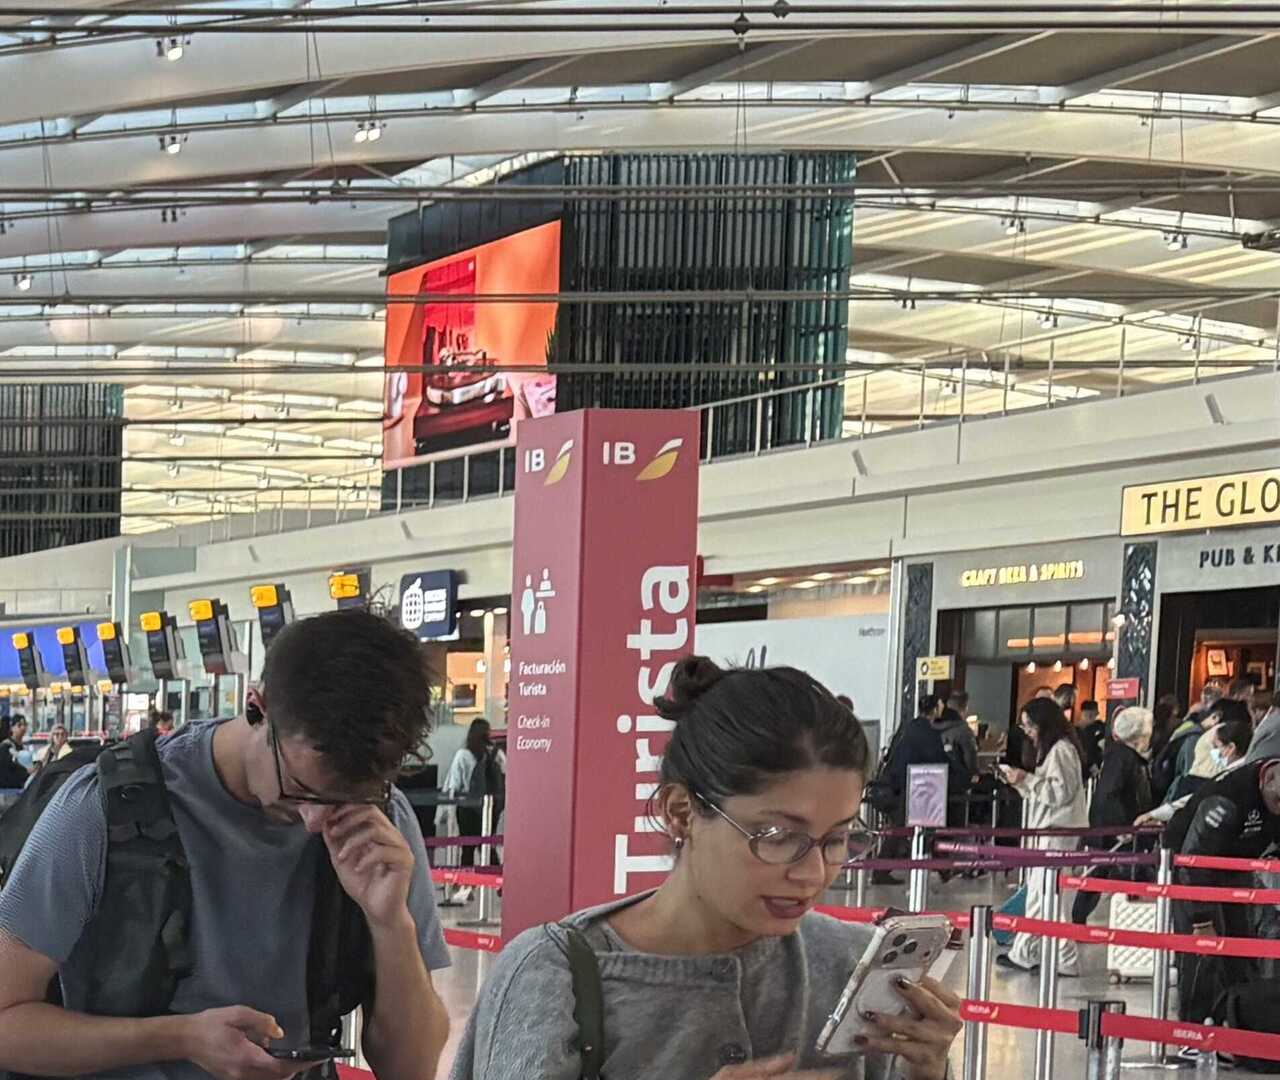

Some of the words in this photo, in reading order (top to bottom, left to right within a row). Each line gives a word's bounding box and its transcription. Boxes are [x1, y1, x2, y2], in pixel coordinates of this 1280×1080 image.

[525, 449, 545, 472] IB
[603, 442, 635, 465] IB
[1141, 486, 1202, 525] THE
[1199, 548, 1235, 568] PUB
[1243, 546, 1255, 565] &
[519, 682, 547, 696] Turista
[517, 714, 550, 729] Check-in
[516, 735, 552, 753] Economy
